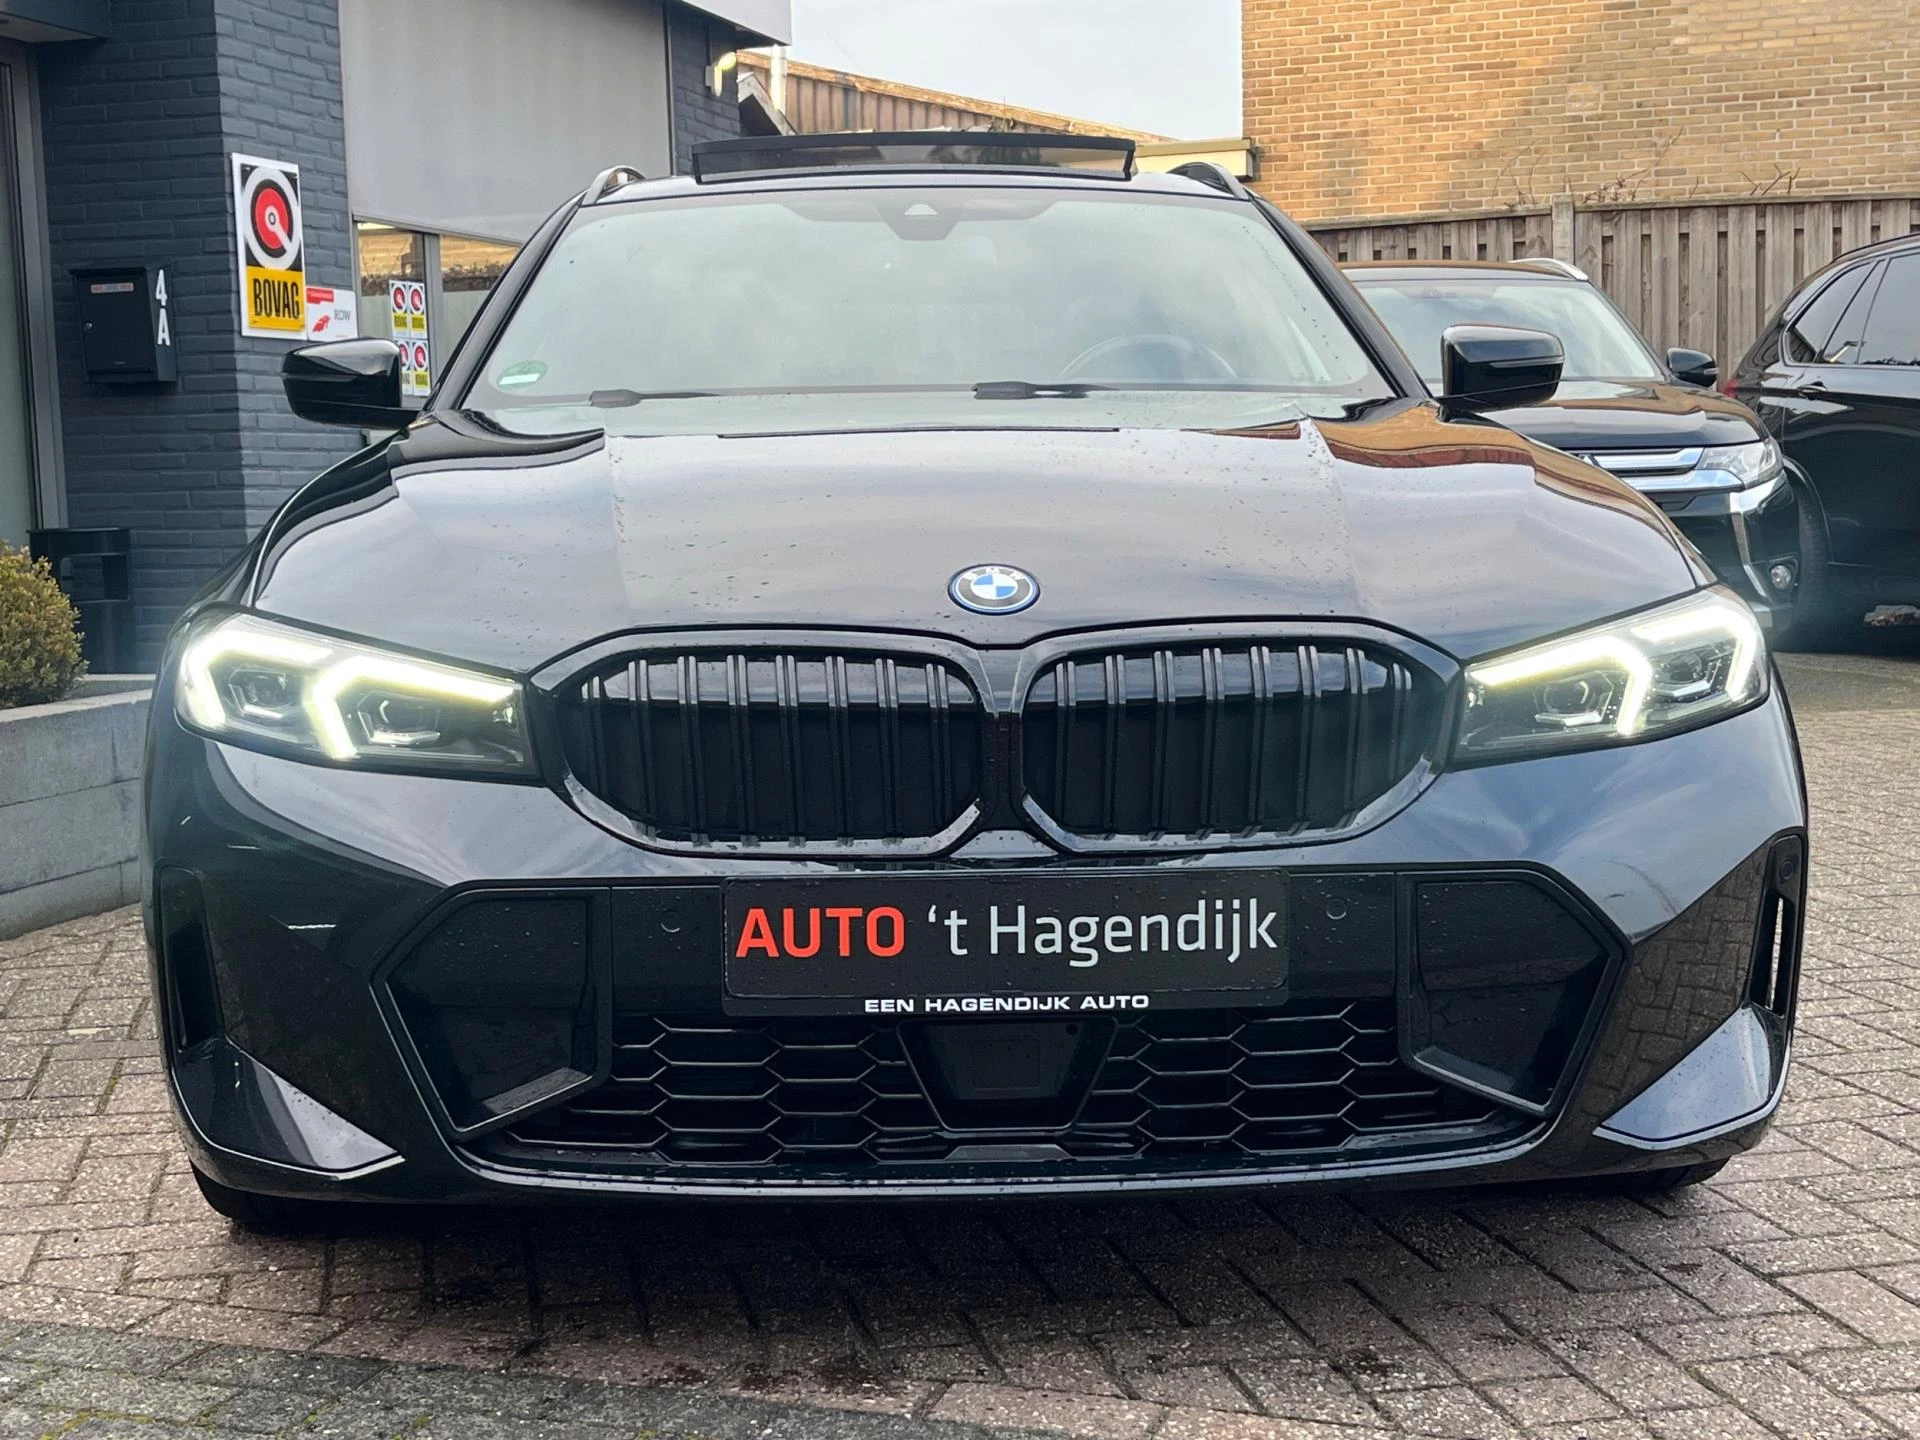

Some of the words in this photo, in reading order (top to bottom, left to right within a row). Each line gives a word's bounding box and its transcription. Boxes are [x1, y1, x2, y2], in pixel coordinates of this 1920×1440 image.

[252, 278, 300, 320] BOVAG
[961, 567, 1024, 581] BMW
[736, 906, 905, 958] AUTO
[990, 897, 1279, 968] Hagendijk
[864, 998, 914, 1014] EEN
[925, 996, 1071, 1013] HAGENDIJK
[1080, 994, 1150, 1011] AUTO
